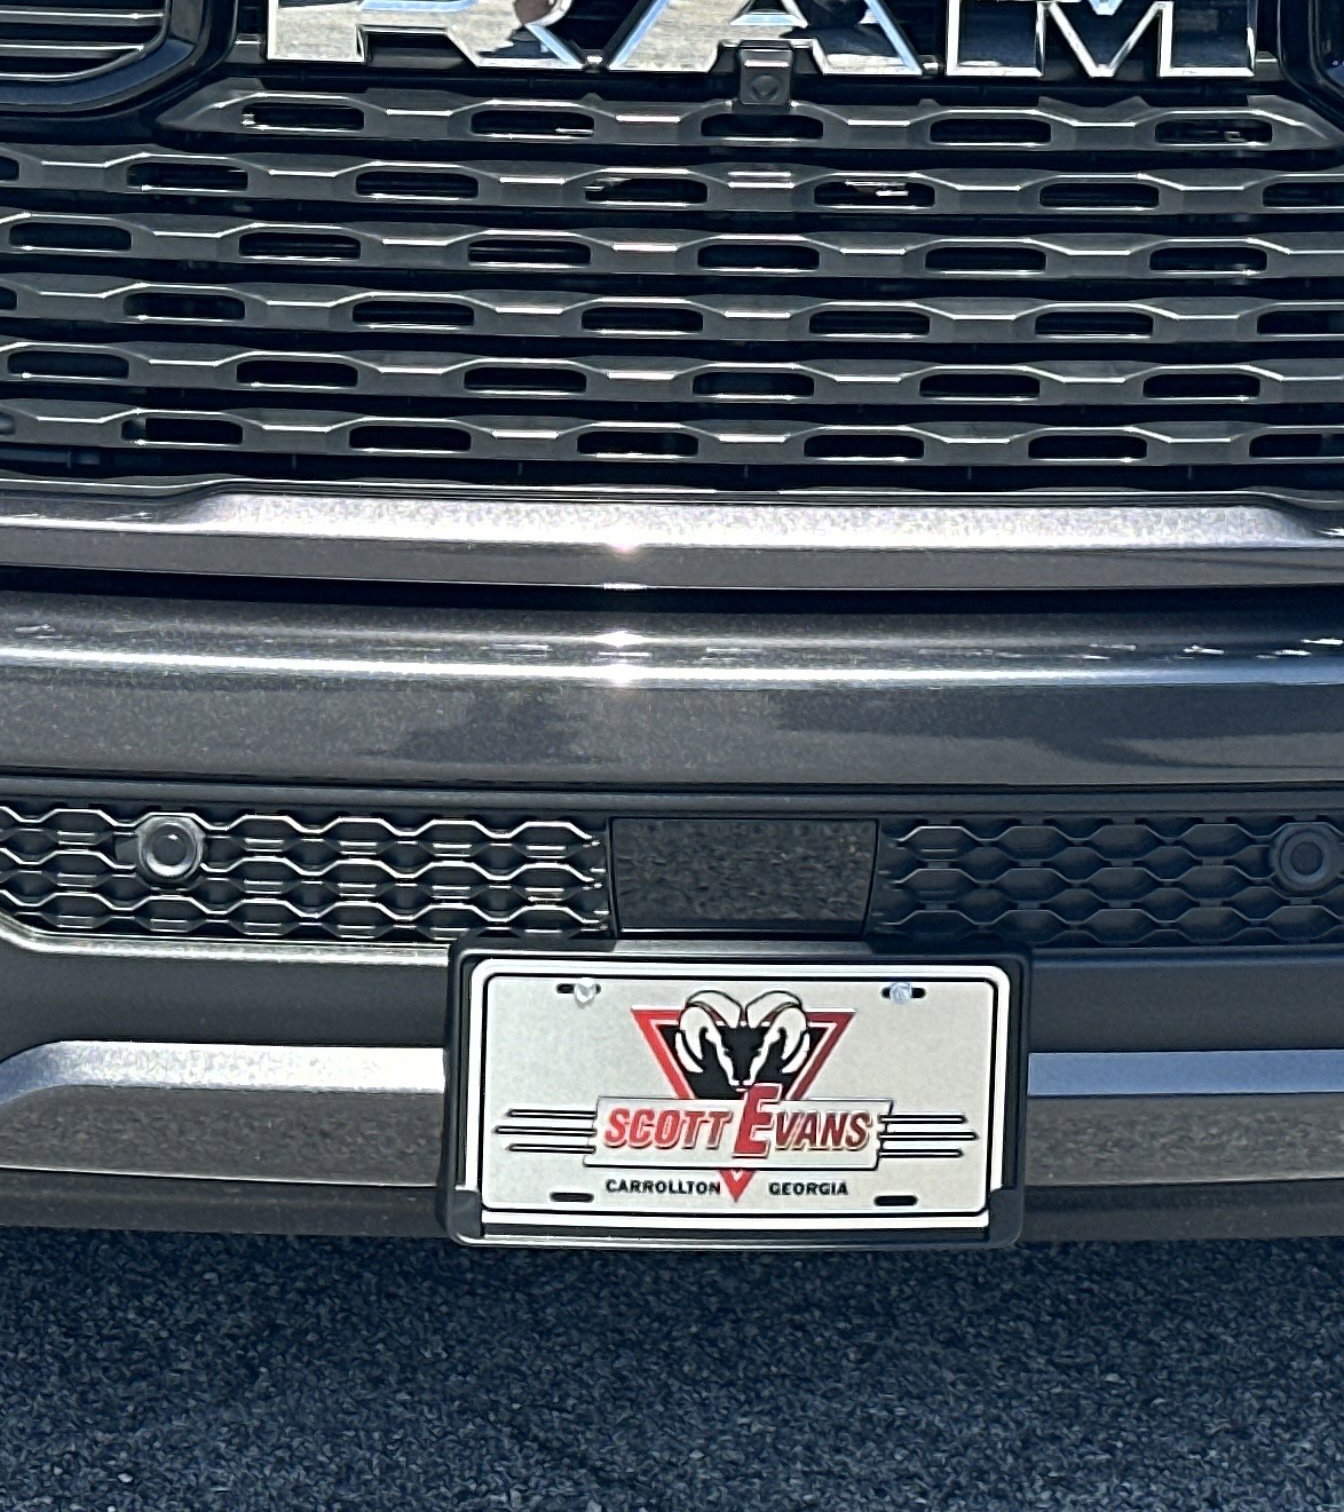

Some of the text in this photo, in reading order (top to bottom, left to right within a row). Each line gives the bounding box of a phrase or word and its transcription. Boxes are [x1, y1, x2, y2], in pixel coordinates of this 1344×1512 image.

[605, 1083, 873, 1159] SCOTT EVANS
[605, 1178, 849, 1197] CARROLLTON GEORGIA
